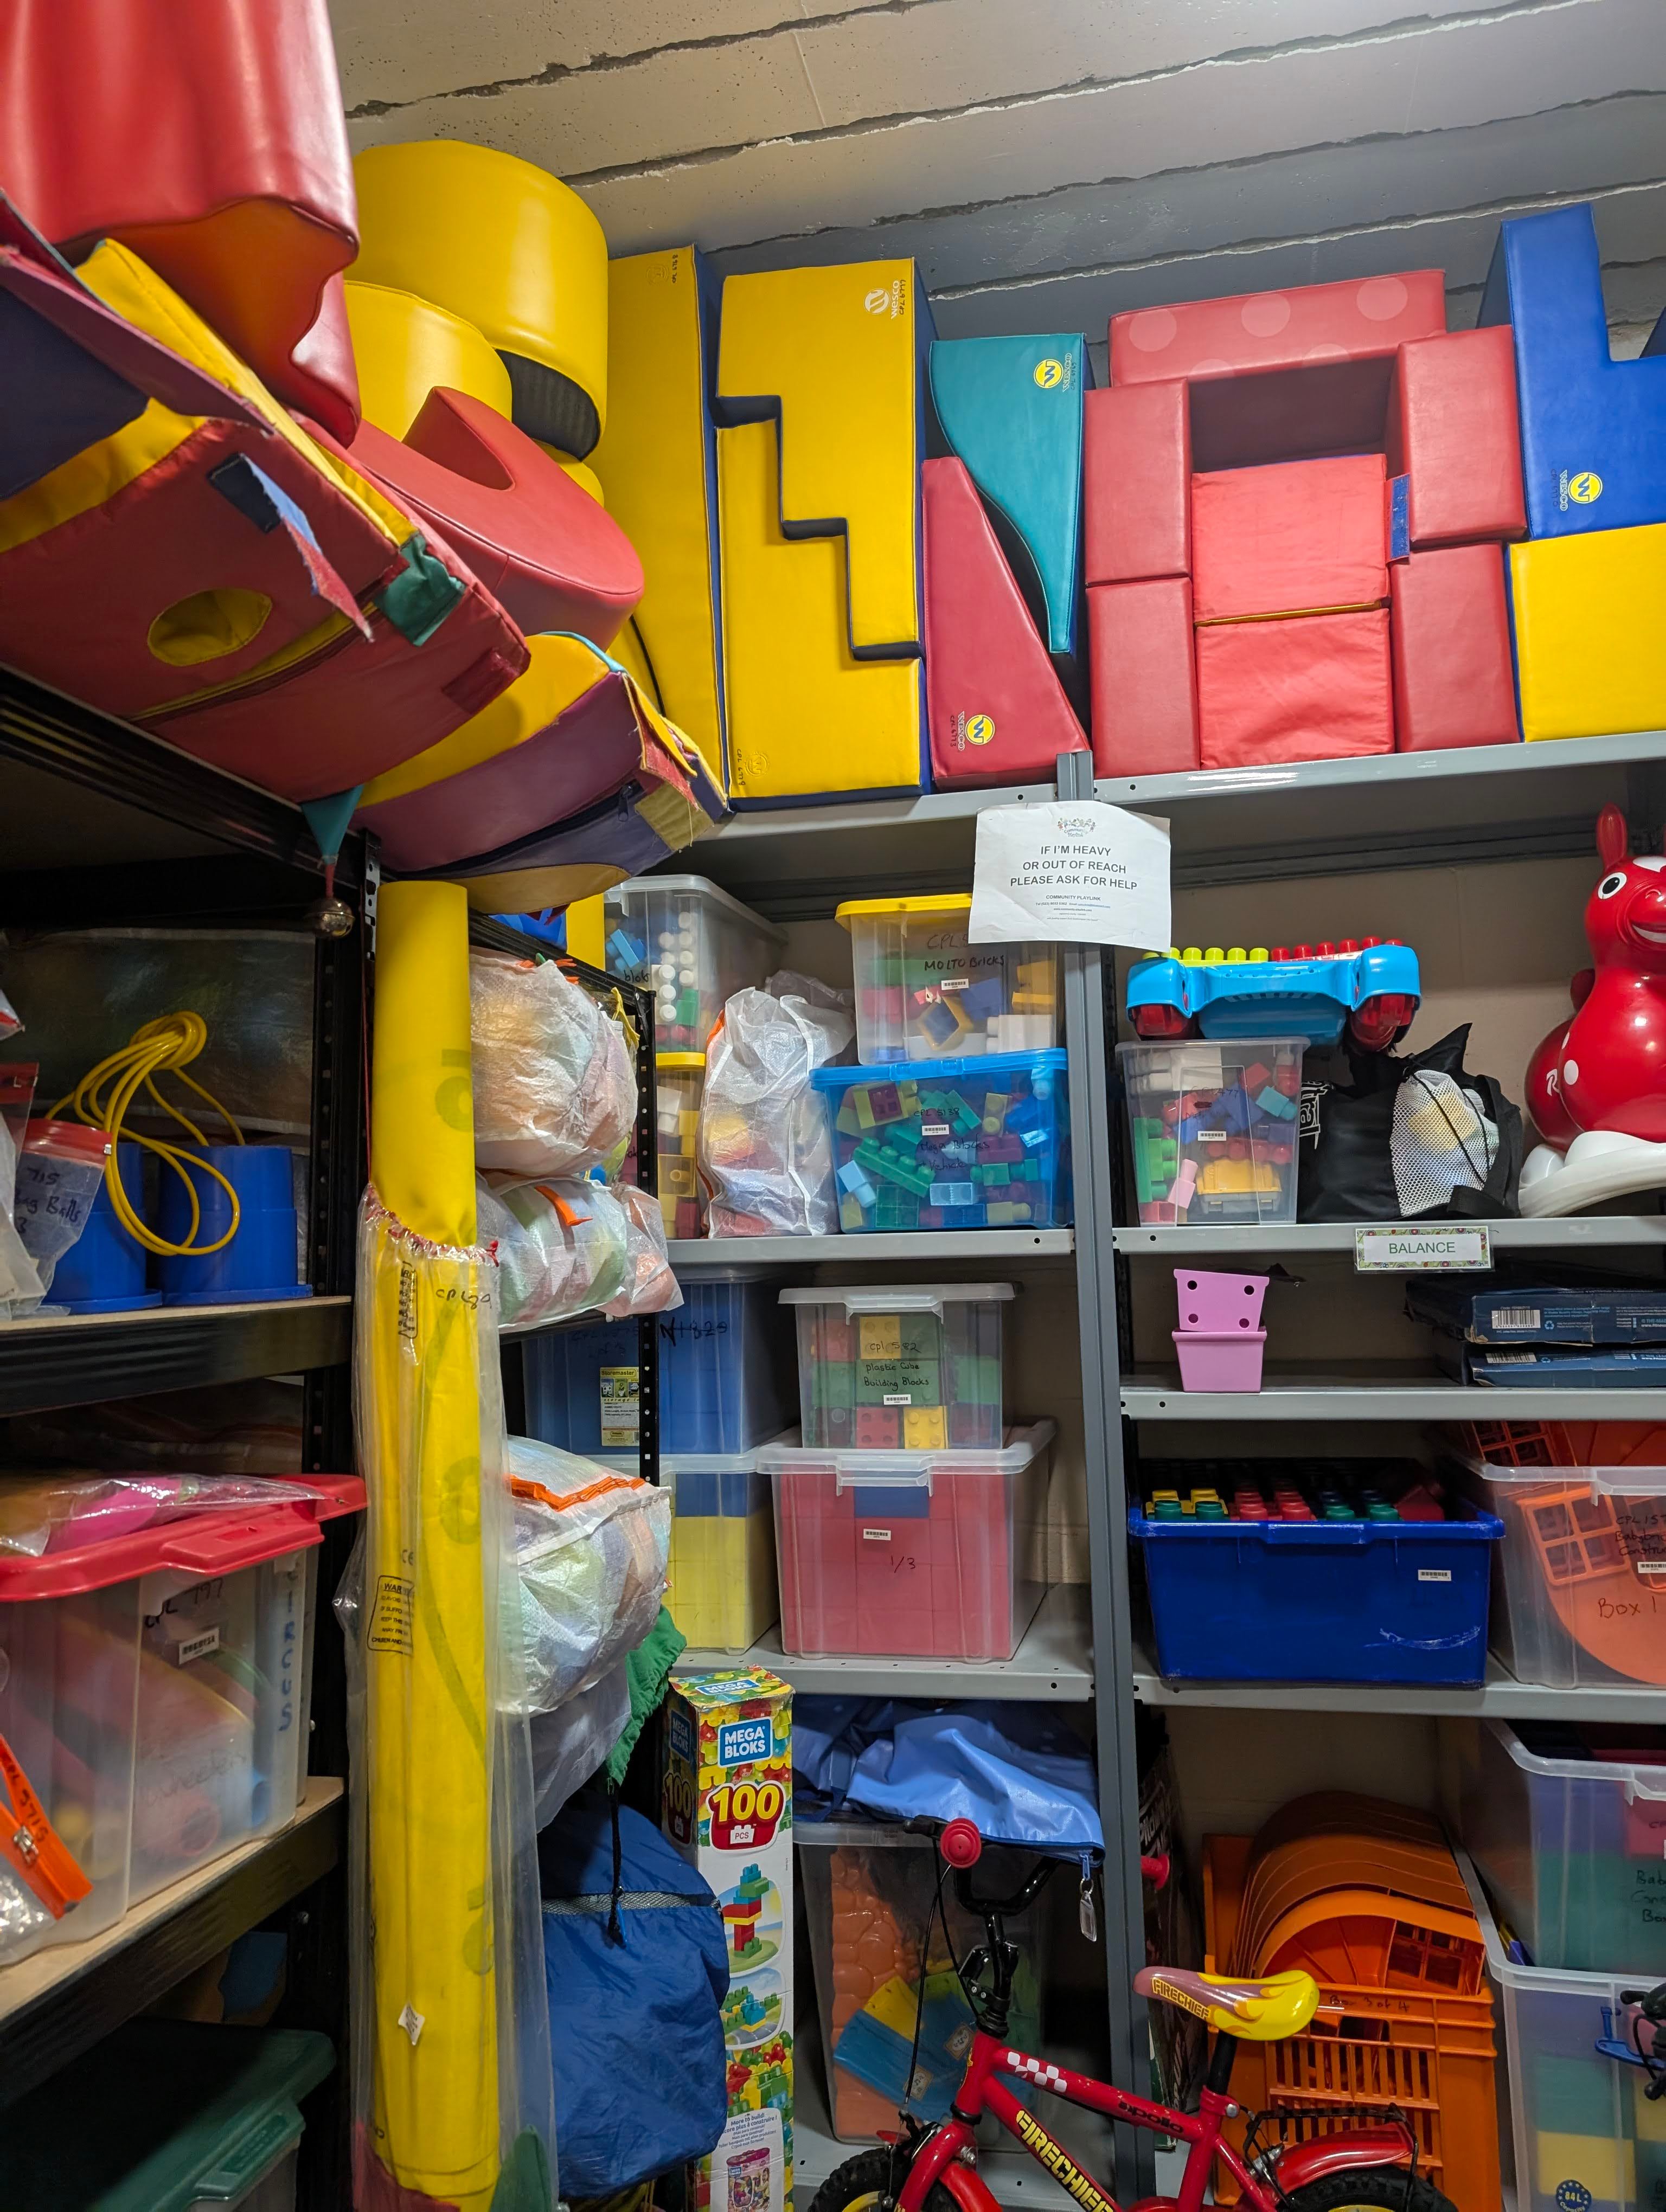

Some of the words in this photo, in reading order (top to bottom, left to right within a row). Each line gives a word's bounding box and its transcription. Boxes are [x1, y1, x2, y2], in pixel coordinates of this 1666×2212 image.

[890, 279, 899, 320] wesco
[1062, 352, 1072, 393] WESCO
[1559, 468, 1568, 511] WESCO
[957, 710, 965, 751] WESCO
[1041, 846, 1051, 855] IF
[1073, 845, 1111, 857] HEAVY
[1023, 861, 1039, 870] OR
[1042, 860, 1067, 870] OUT
[1069, 860, 1085, 869] OF
[1088, 861, 1126, 874] REACH
[1010, 875, 1053, 886] PLEASE
[1056, 876, 1080, 884] ASK
[1084, 876, 1107, 886] FOR
[1110, 878, 1137, 890] HELP
[927, 934, 958, 949] CPL
[937, 1107, 960, 1116] 5138
[1389, 1242, 1456, 1254] BALANCE
[863, 1376, 899, 1392] Building
[901, 1377, 929, 1386] Blocks
[1598, 1597, 1641, 1619] Box
[704, 1682, 746, 1691] MEGA
[672, 1718, 689, 1735] MEGA
[725, 1726, 765, 1744] MEGA
[672, 1732, 689, 1752] BLOKS
[725, 1740, 766, 1759] BLOKS
[664, 1772, 693, 1818] 100
[713, 1785, 780, 1822] 100
[734, 1831, 749, 1840] PCS
[1152, 1977, 1210, 2020] FIRECHIEF
[736, 2123, 746, 2131] plus
[751, 2117, 774, 2126] construire
